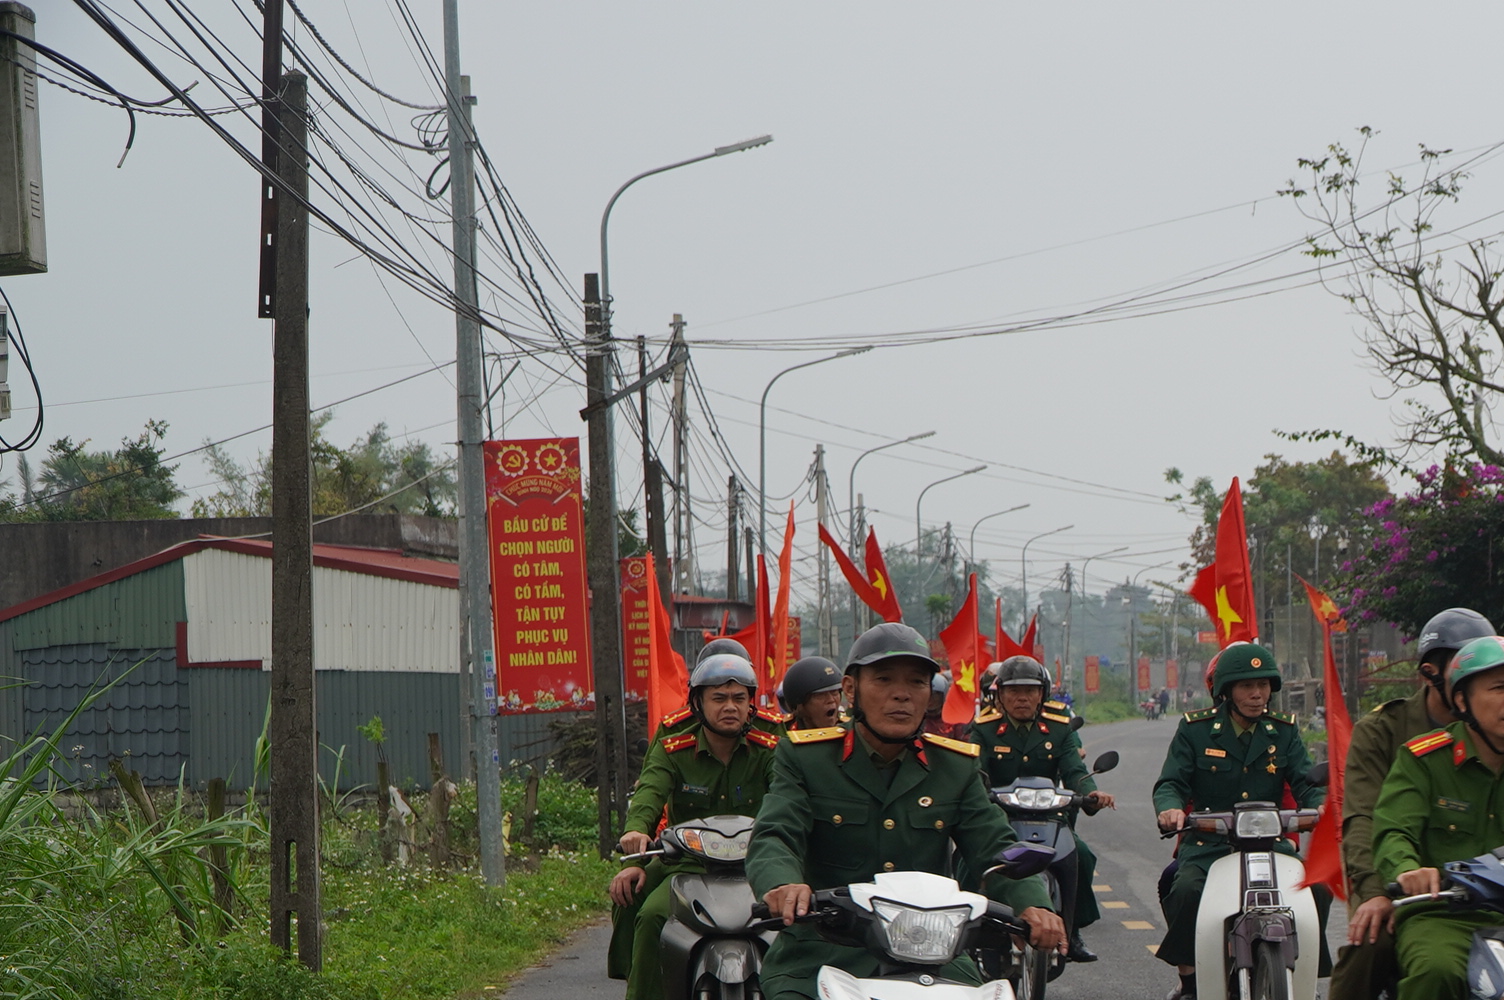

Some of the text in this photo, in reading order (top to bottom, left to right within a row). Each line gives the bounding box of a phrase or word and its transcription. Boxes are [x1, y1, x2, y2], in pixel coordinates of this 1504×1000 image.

[504, 512, 567, 533] BẦU CỬ ĐỂ
[500, 536, 574, 558] CHỌN NGƯỜI
[514, 560, 563, 577] CÓ TÂM,
[515, 581, 565, 599] CÓ TẦM,
[516, 605, 565, 624] TẬN TỤY
[516, 628, 569, 646] PHỤC VỤ
[509, 649, 544, 667] NHÂN
[547, 648, 577, 665] DÂN!
